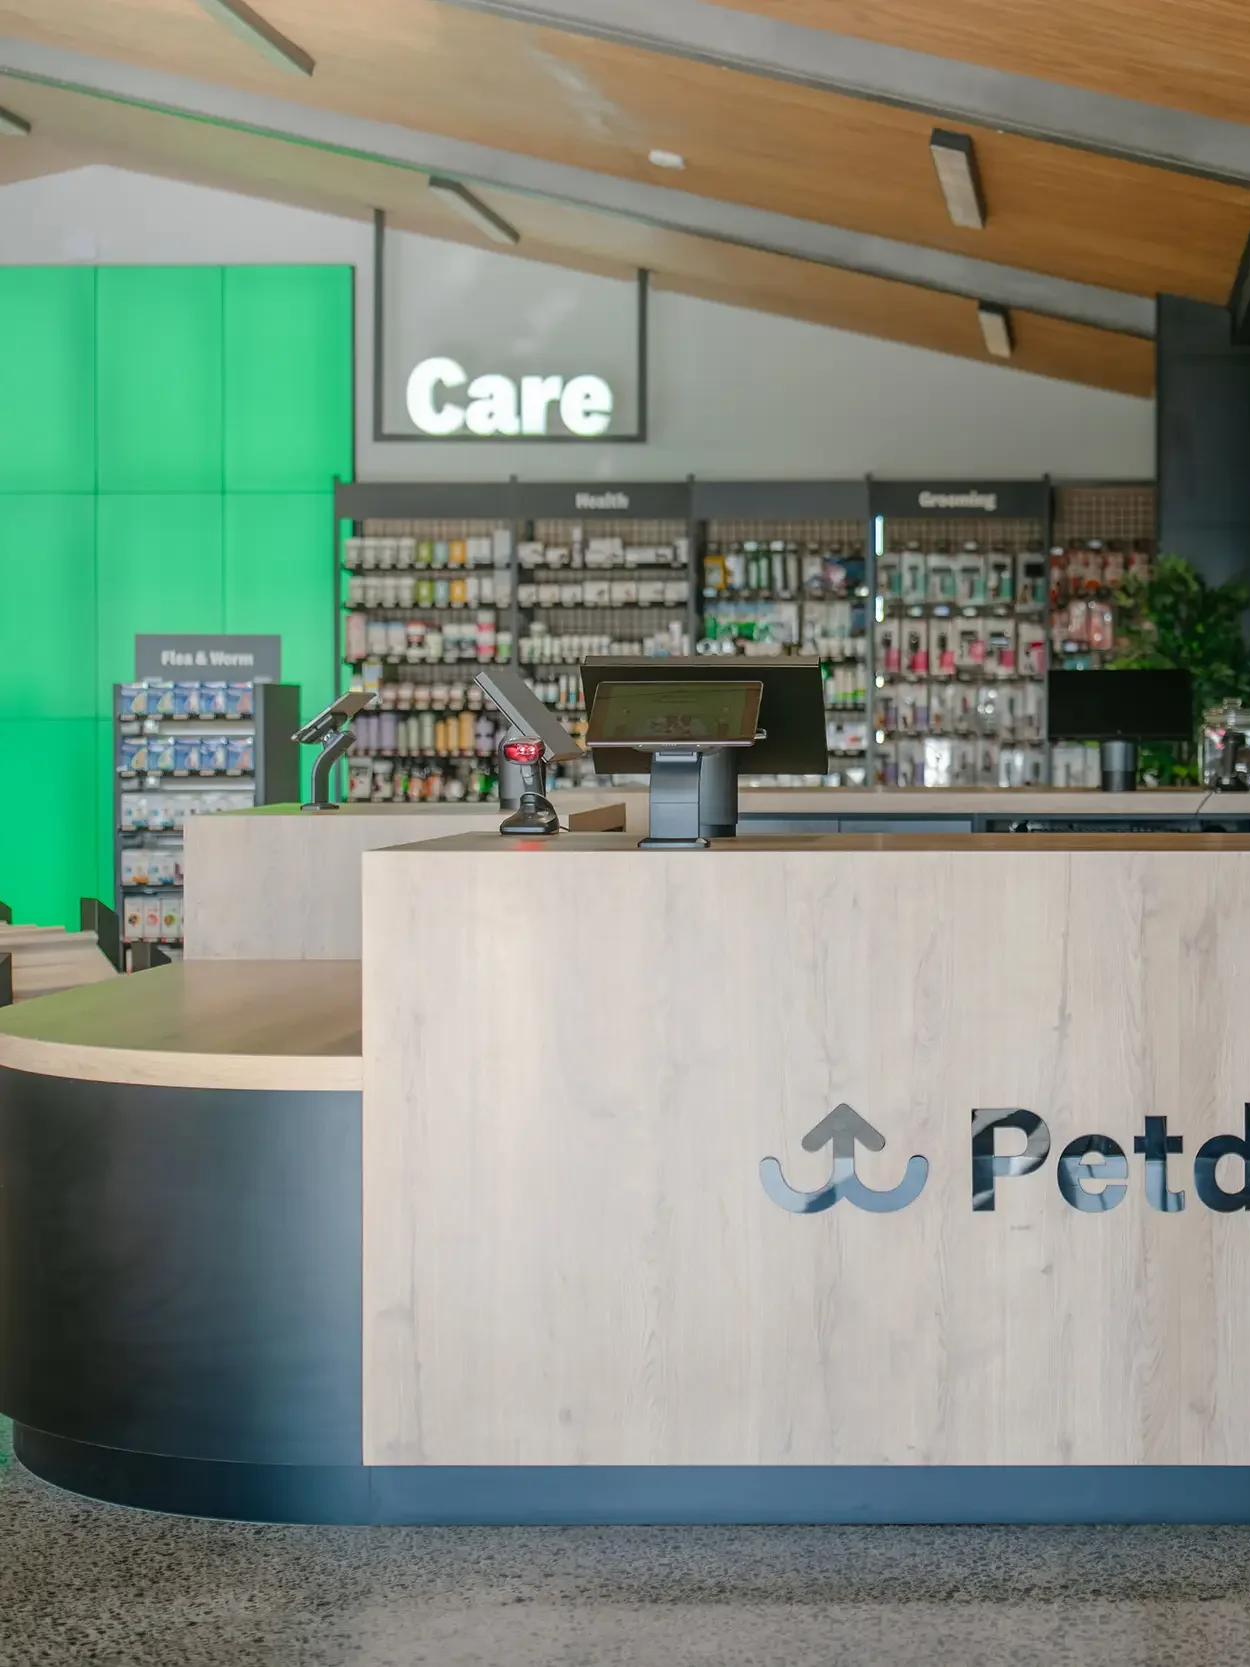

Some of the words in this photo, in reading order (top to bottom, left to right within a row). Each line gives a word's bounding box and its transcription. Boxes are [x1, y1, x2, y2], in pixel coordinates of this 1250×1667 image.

[406, 357, 613, 436] Care
[575, 490, 630, 510] Health
[919, 489, 998, 511] Grooming
[161, 650, 193, 666] Flea
[195, 651, 206, 666] &
[210, 651, 254, 666] Worm
